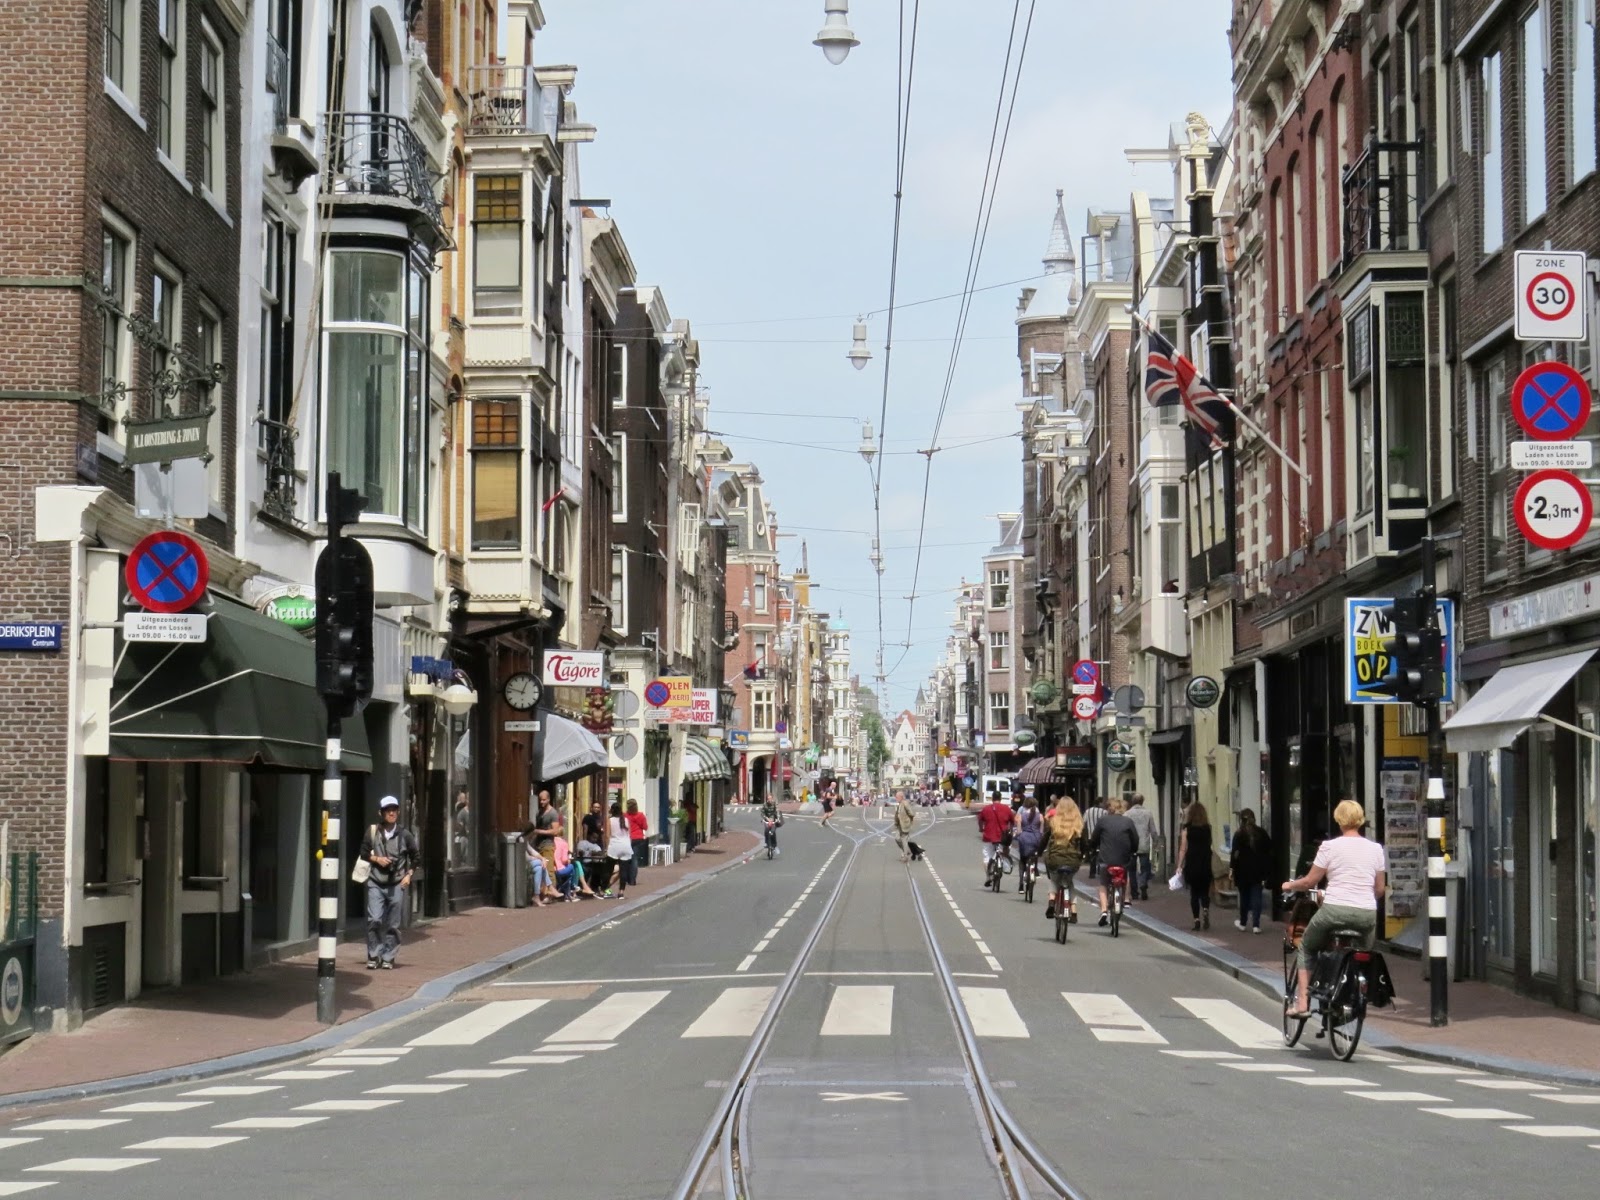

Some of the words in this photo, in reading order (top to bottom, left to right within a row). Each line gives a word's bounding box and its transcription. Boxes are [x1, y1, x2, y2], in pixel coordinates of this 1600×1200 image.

[1536, 259, 1565, 267] ZONE
[1536, 287, 1566, 305] 30
[176, 429, 183, 444] &
[1534, 496, 1571, 521] 2,3m
[0, 626, 55, 637] DERIKSPLEIN
[32, 639, 55, 647] Centrum
[547, 655, 600, 682] Tagore
[667, 682, 689, 690] OLEN
[692, 700, 710, 710] UPER
[692, 712, 714, 722] ARKET
